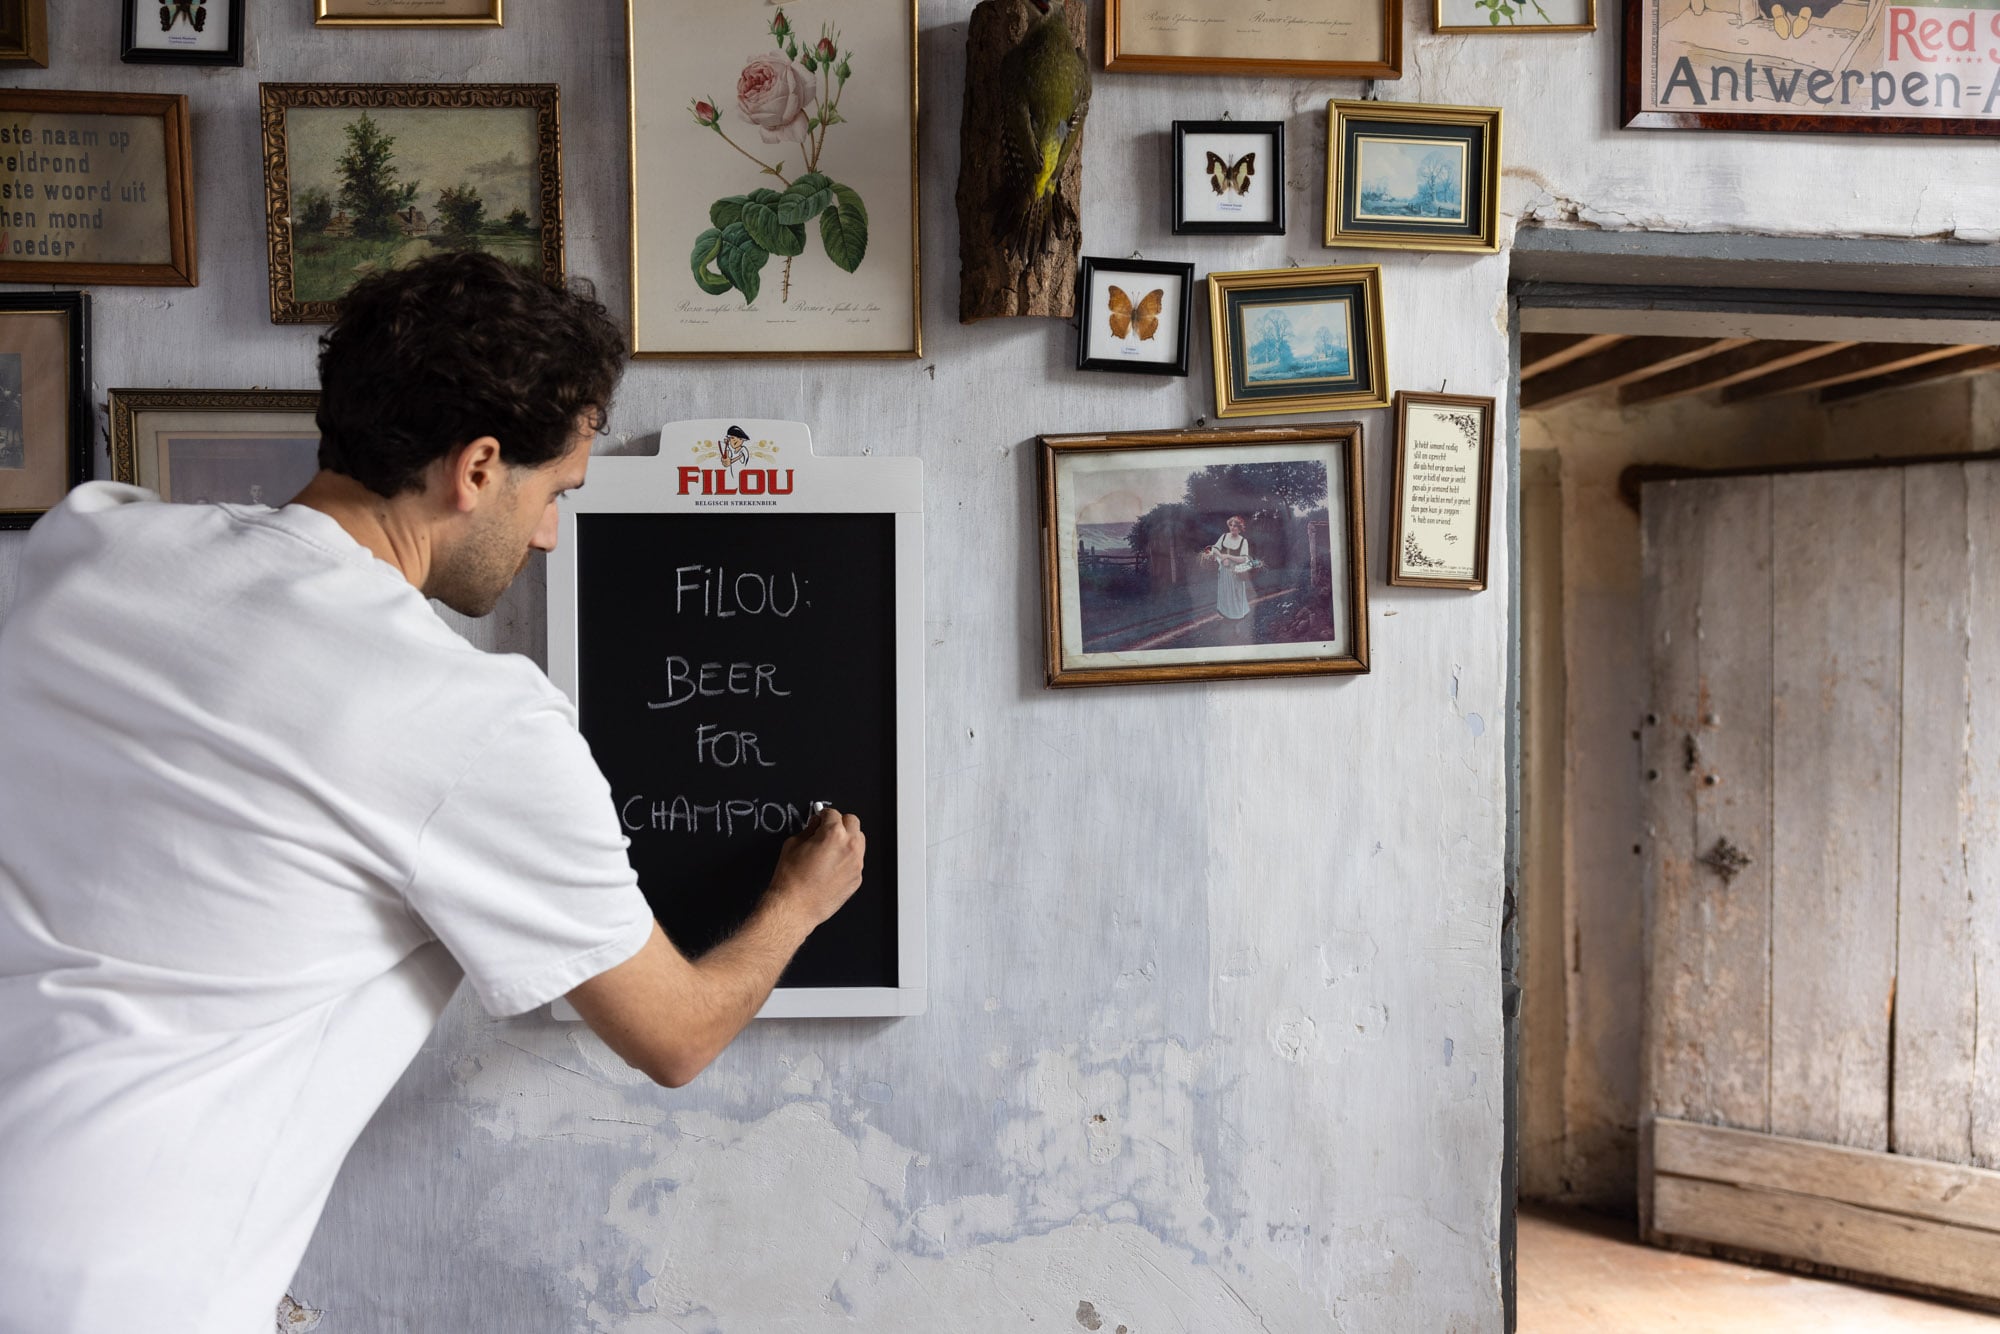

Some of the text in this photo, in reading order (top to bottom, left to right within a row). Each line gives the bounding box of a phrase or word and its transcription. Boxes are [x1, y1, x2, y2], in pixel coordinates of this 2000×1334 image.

[1889, 8, 1976, 62] Red
[42, 128, 99, 147] naam
[109, 131, 130, 153] op
[0, 151, 90, 173] eldrond
[44, 180, 112, 202] woord
[121, 181, 147, 202] uit
[49, 208, 103, 229] mond
[676, 466, 794, 496] FILOU
[648, 656, 791, 709] BEER
[696, 724, 776, 767] FOR
